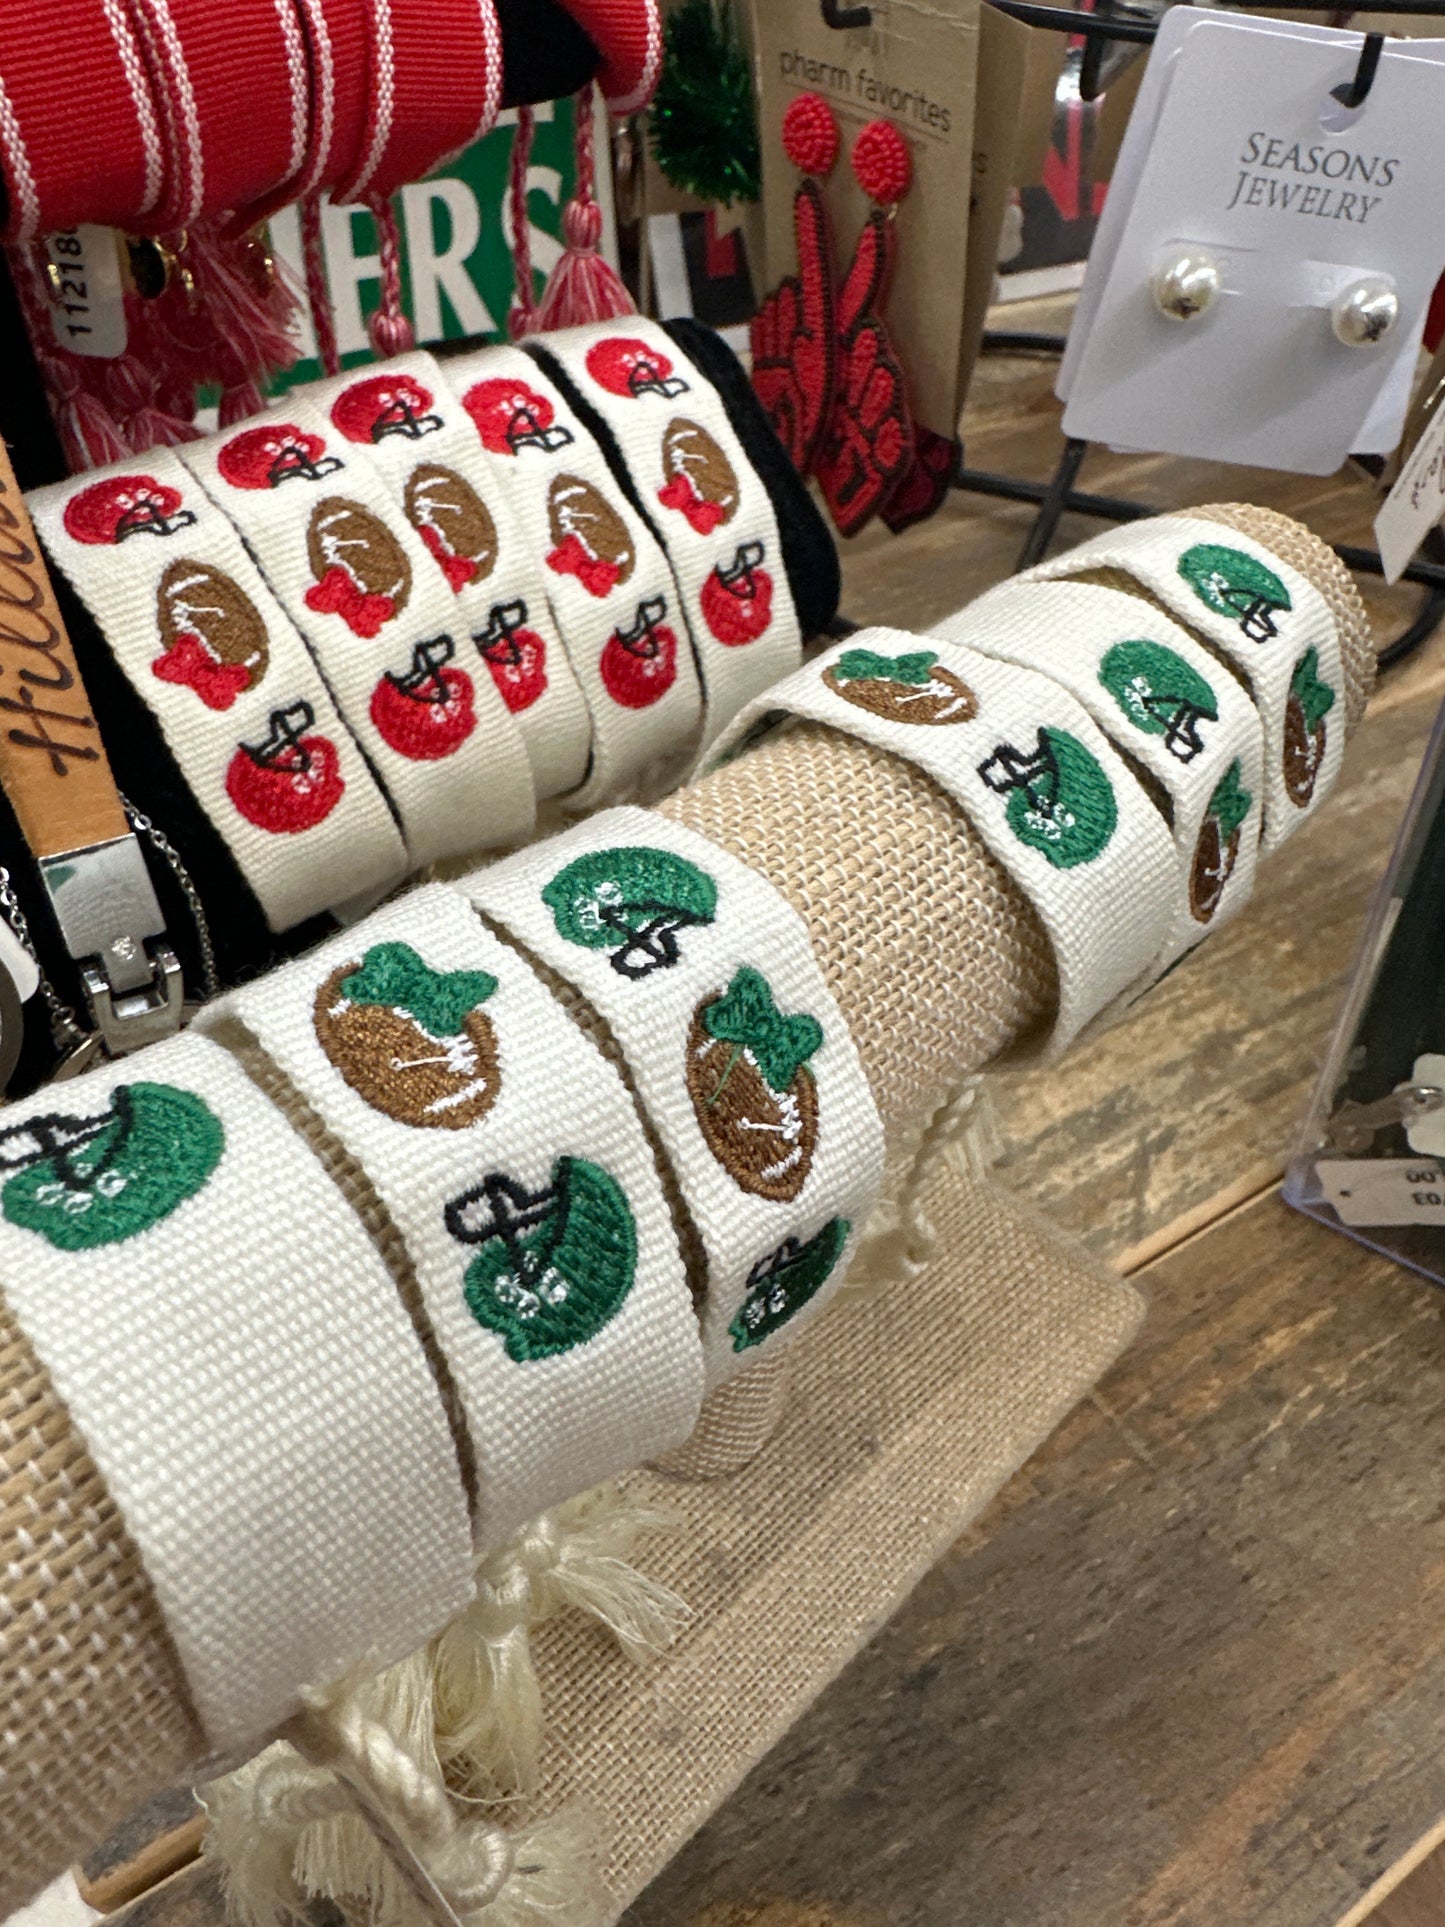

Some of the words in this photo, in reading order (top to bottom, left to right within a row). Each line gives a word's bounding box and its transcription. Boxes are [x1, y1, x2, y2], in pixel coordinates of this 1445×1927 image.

[779, 49, 850, 93] pharm
[855, 67, 951, 133] favorites
[1241, 132, 1400, 187] SEASONS
[1226, 171, 1382, 223] JEWELRY
[55, 228, 93, 337] 11218
